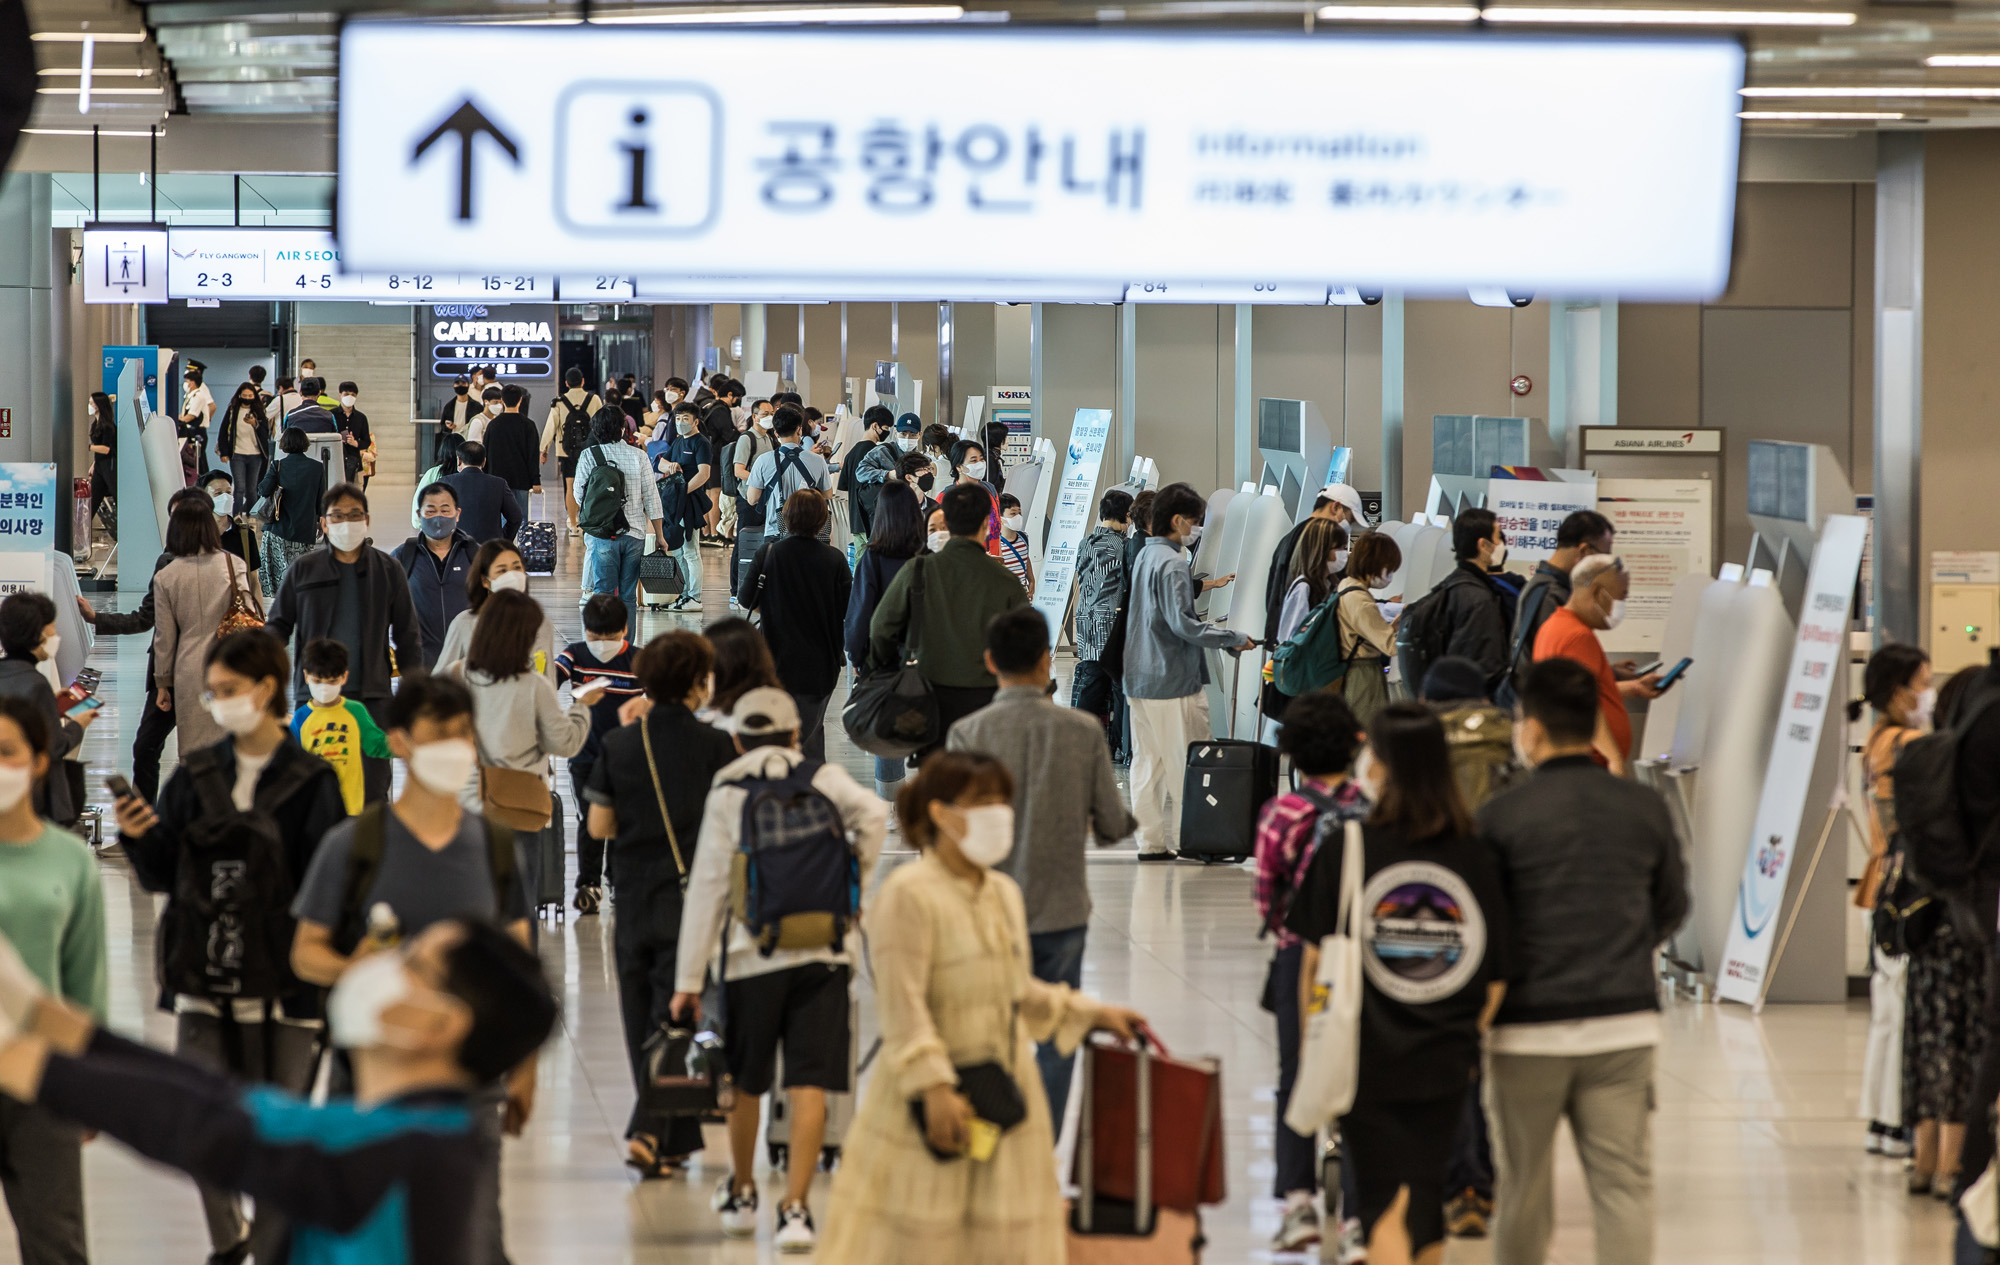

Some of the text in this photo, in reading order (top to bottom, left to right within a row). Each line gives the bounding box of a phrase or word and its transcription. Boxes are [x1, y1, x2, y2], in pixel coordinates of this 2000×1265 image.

[755, 117, 1146, 214] 공항안내
[276, 251, 300, 260] AIR
[197, 273, 232, 287] 2~3
[296, 274, 331, 288] 4~5
[388, 275, 433, 290] 8~12
[481, 275, 535, 291] 15~21
[433, 321, 552, 341] CAFETERIA
[998, 391, 1031, 399] KOREA
[1614, 440, 1685, 448] ASIANA AIRLINES
[0, 493, 43, 509] 분확인
[0, 519, 43, 535] 의사항
[1505, 535, 1558, 550] 비해주세요
